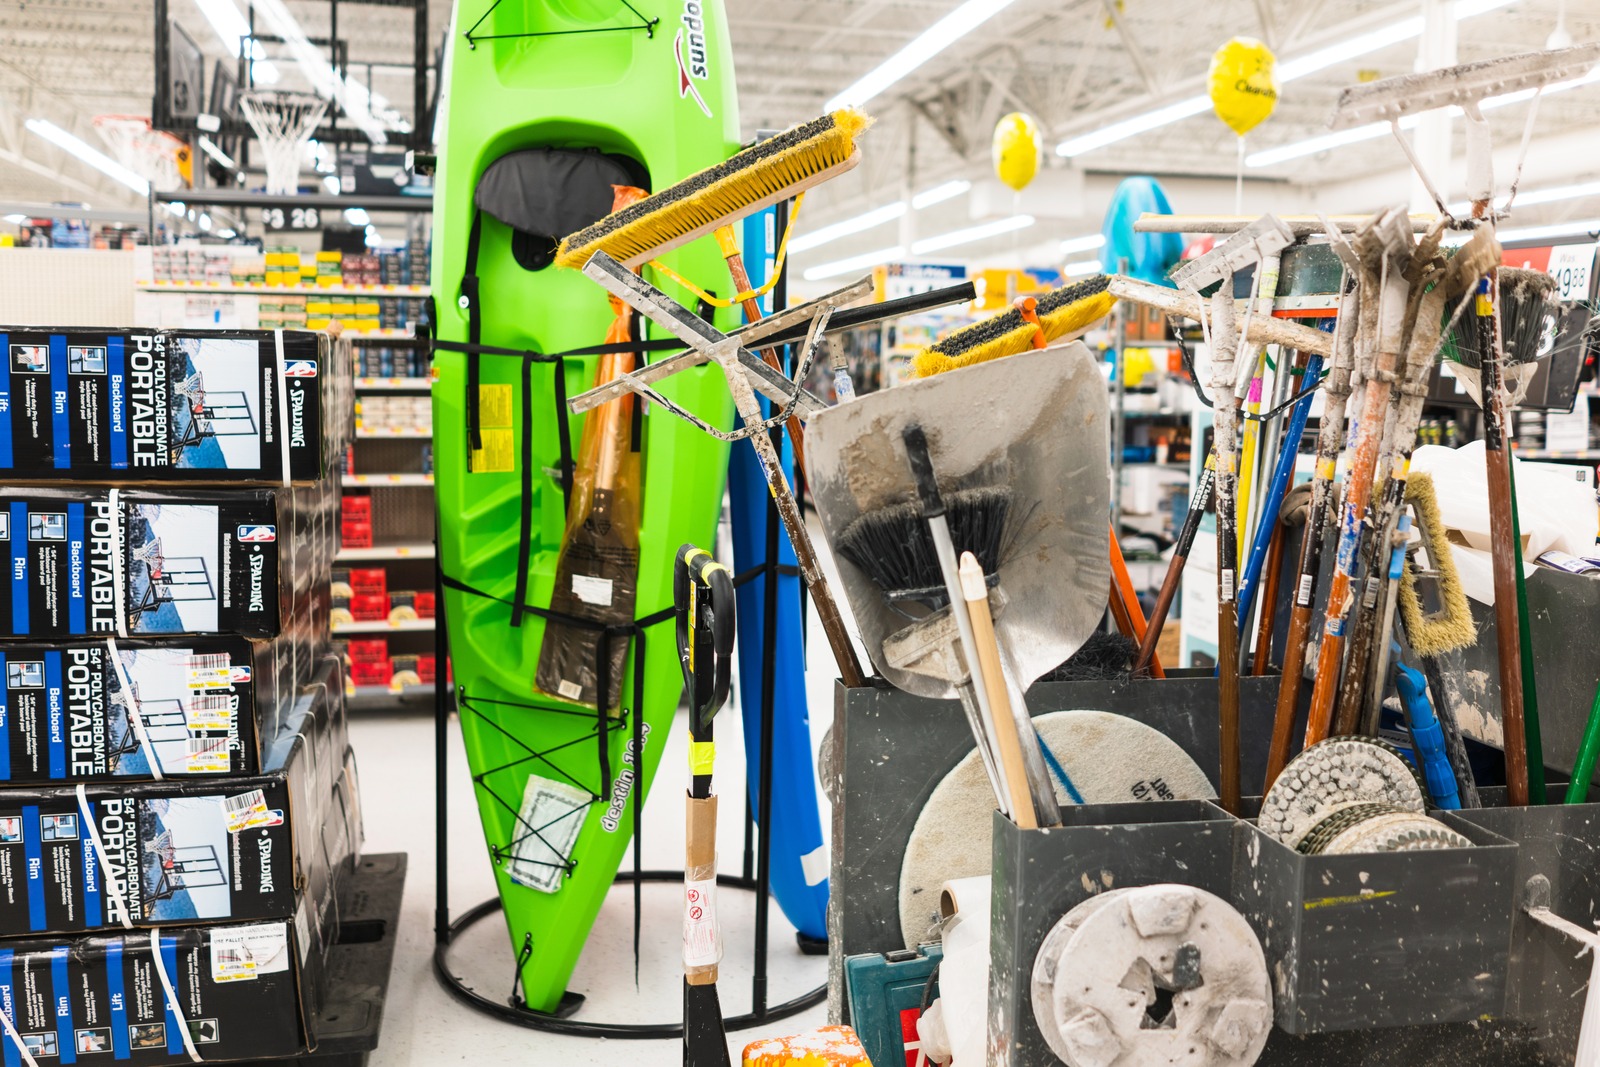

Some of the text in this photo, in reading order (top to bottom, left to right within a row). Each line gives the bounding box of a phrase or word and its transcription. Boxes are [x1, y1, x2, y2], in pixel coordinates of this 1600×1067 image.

[54, 391, 66, 414] Rim
[111, 374, 124, 432] Backboard
[130, 335, 156, 467] PORTABLE
[154, 360, 168, 466] POLYCARBONATE
[290, 388, 306, 448] SPALDING
[1191, 468, 1211, 511] SQUEEGEE
[1198, 484, 1212, 511] FLOOR
[14, 557, 26, 580] Rim
[71, 541, 82, 598] Backboard
[92, 501, 114, 632] PORTABLE
[248, 554, 264, 612] SPALDING
[49, 687, 62, 743] Backboard
[67, 649, 93, 776] PORTABLE
[91, 672, 106, 774] POLYCARBONATE
[602, 774, 634, 832] destin
[1149, 777, 1174, 801] GRIT
[28, 857, 40, 880] Rim
[83, 838, 97, 892] Backboard
[124, 821, 141, 920] POLYCARBONATE
[257, 838, 275, 893] SPALDING
[23, 956, 31, 989] polycarbonat
[0, 985, 14, 1035] ckboard
[57, 996, 69, 1016] Rim
[111, 992, 123, 1011] Lift
